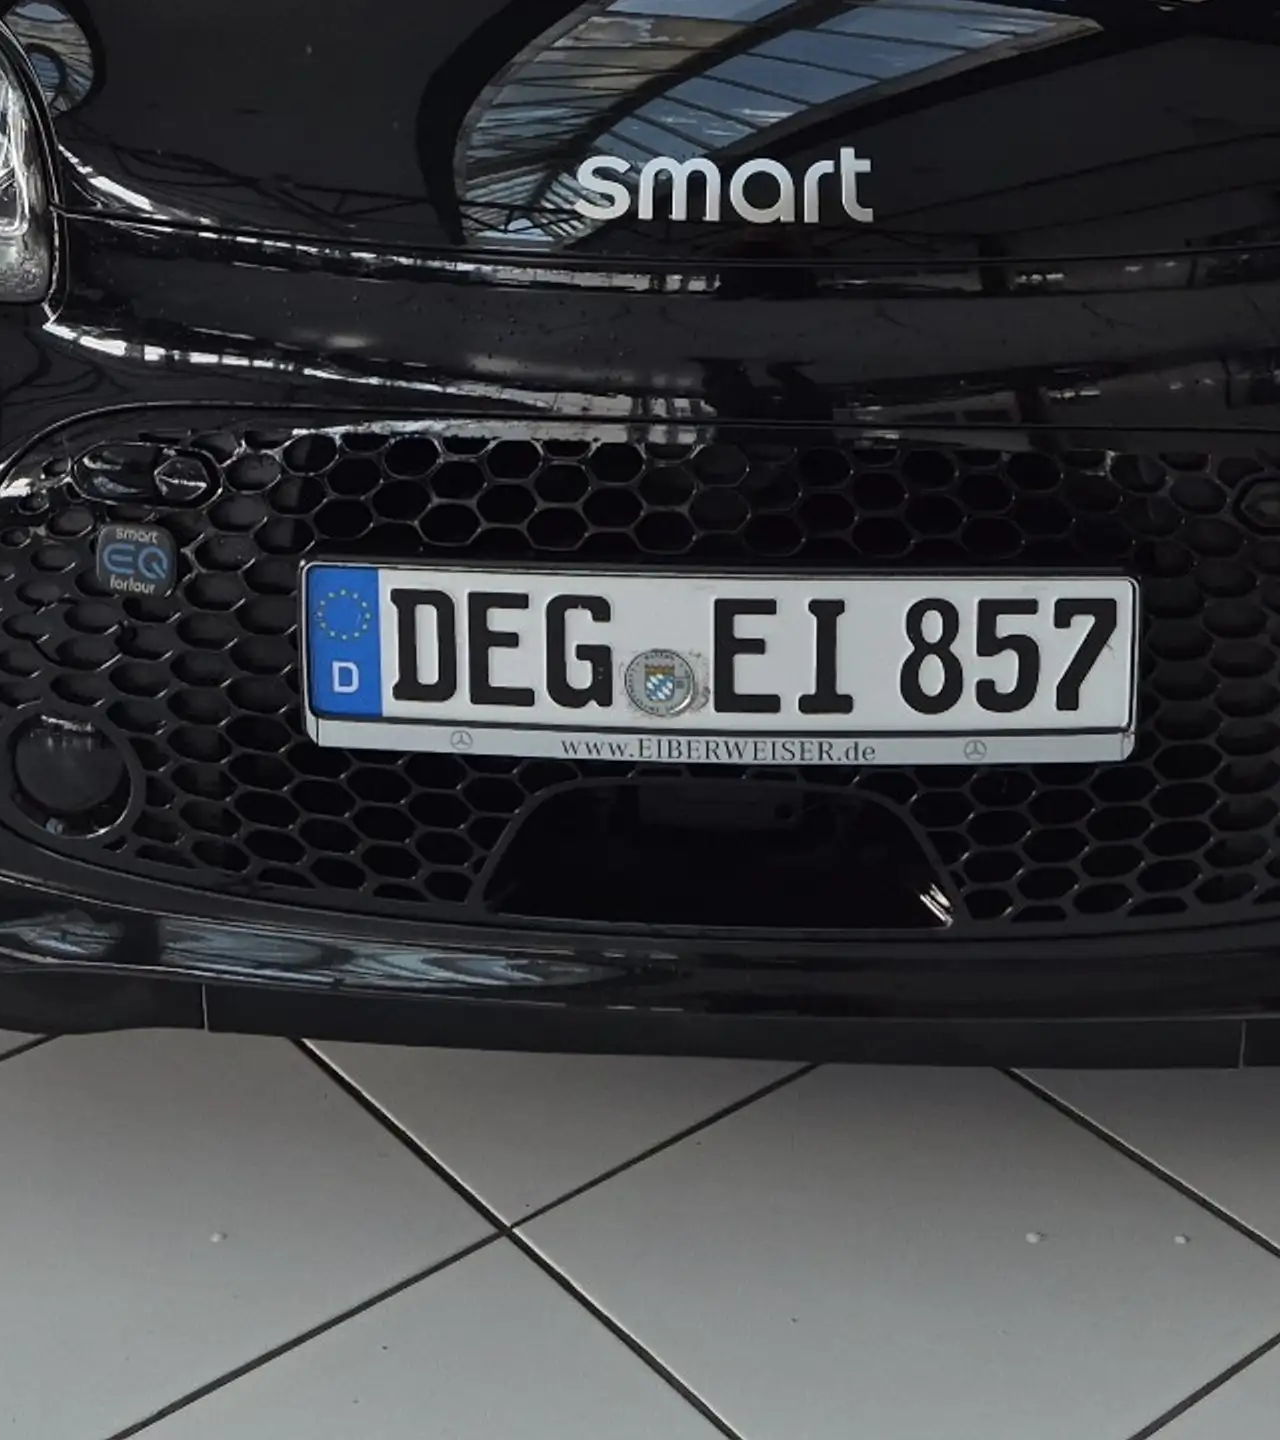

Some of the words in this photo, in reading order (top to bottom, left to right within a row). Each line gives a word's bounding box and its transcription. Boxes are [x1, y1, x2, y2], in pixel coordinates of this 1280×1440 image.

[574, 146, 874, 223] smart
[116, 528, 158, 545] smart
[103, 543, 168, 580] EQ
[110, 573, 156, 595] forfour
[390, 588, 613, 708] DEG
[713, 597, 854, 715] EI
[899, 597, 1118, 715] 857
[332, 660, 359, 693] D
[560, 737, 877, 762] www.EIBERWEISER.de
